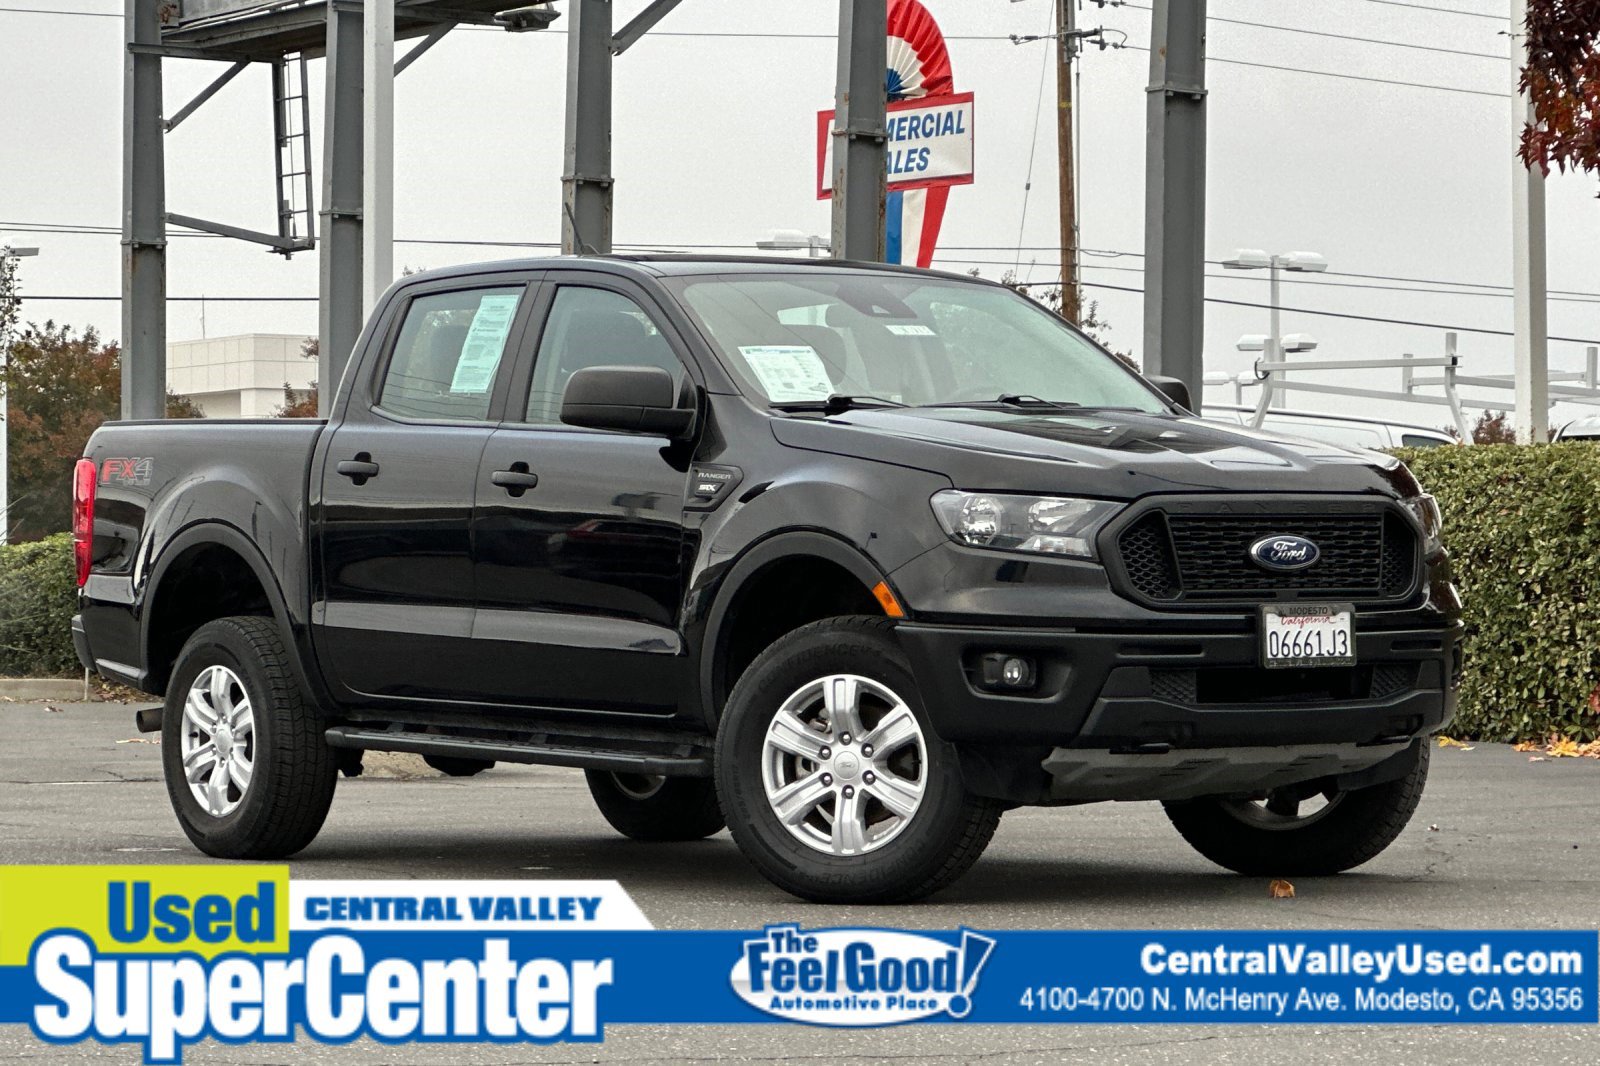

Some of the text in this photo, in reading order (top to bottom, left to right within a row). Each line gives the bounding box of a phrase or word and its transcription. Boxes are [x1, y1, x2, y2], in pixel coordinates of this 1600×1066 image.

[101, 456, 154, 485] FX4
[698, 472, 732, 480] RANGER
[1270, 540, 1308, 562] Ford
[1289, 606, 1329, 616] MODESTO
[1281, 615, 1337, 629] California
[1269, 629, 1349, 658] 06661J3
